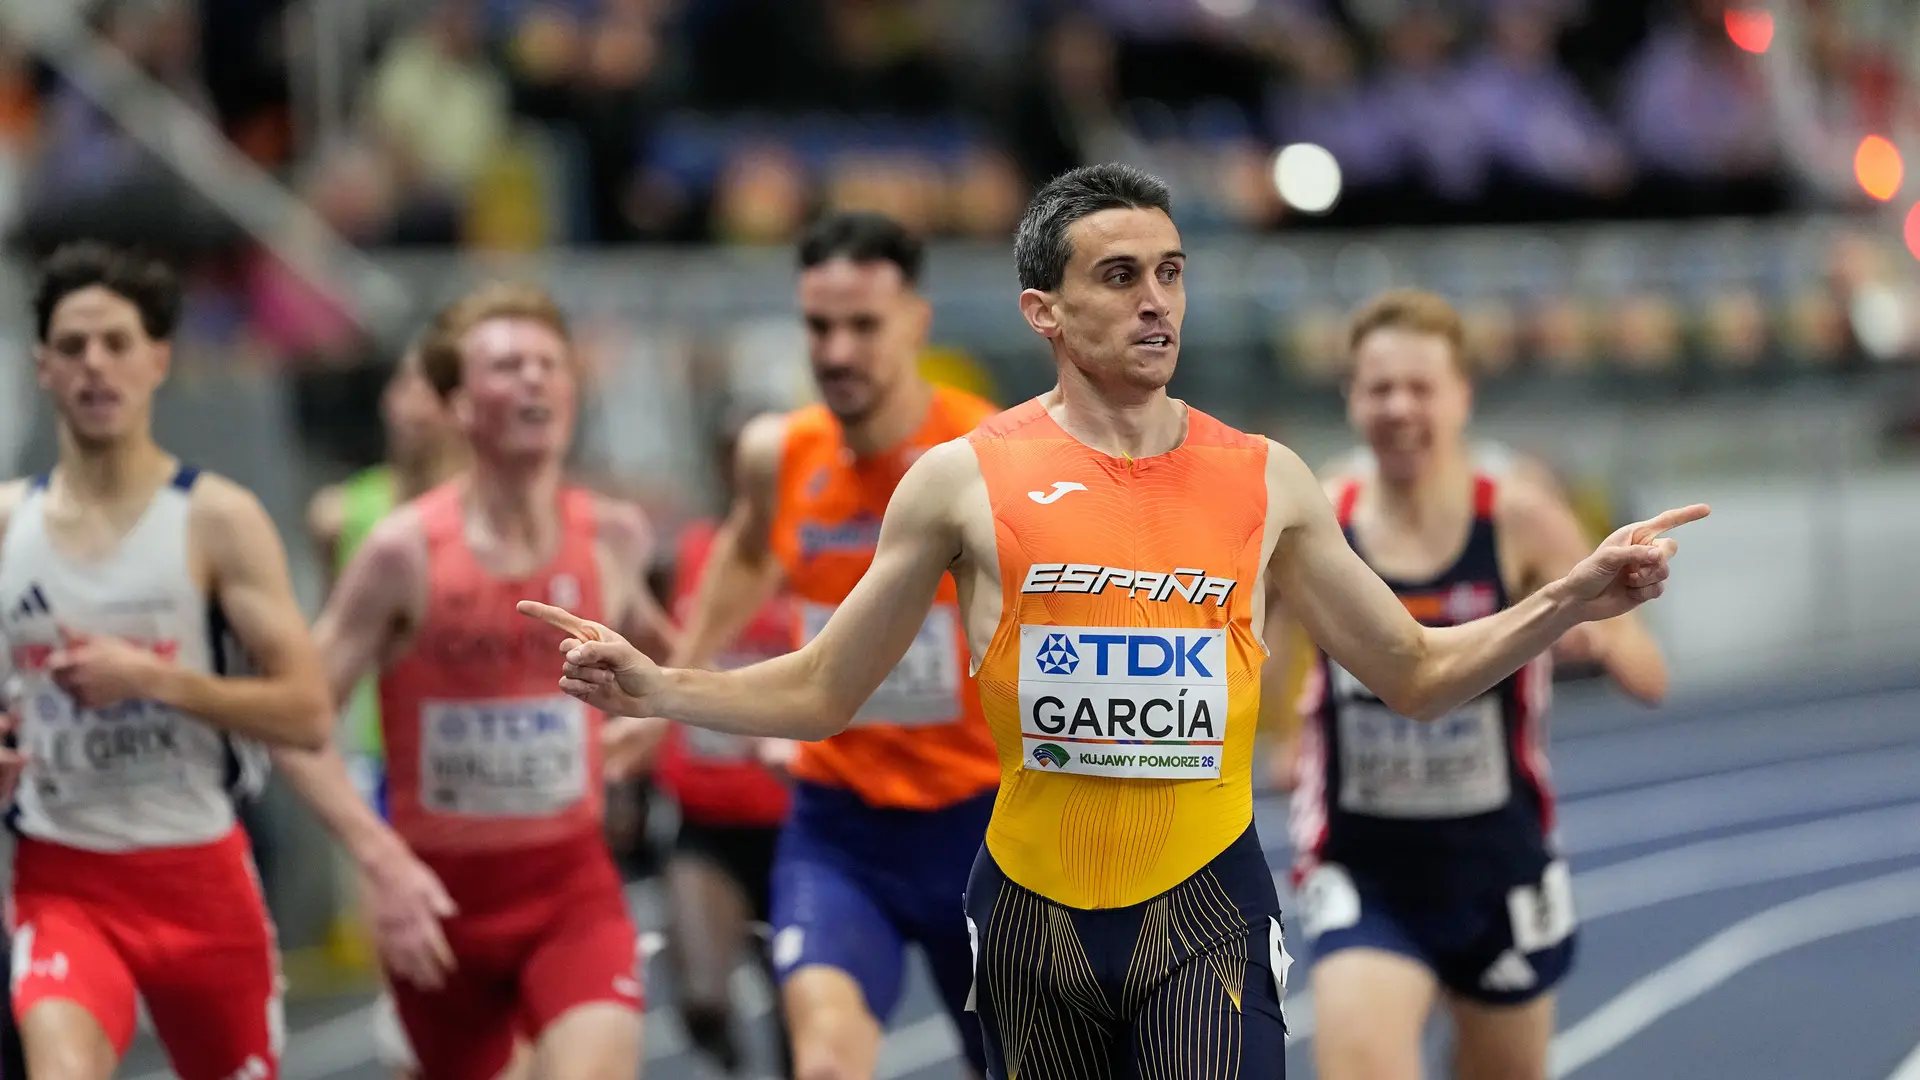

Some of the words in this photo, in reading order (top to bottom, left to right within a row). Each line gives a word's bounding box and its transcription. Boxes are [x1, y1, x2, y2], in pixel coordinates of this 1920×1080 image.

[1021, 564, 1237, 606] ESPAÑA
[1079, 634, 1213, 677] TDK
[1033, 688, 1214, 738] GARCÍA
[1080, 753, 1136, 767] KUJAWY
[1139, 755, 1200, 768] POMORZE
[1201, 756, 1214, 767] 26
